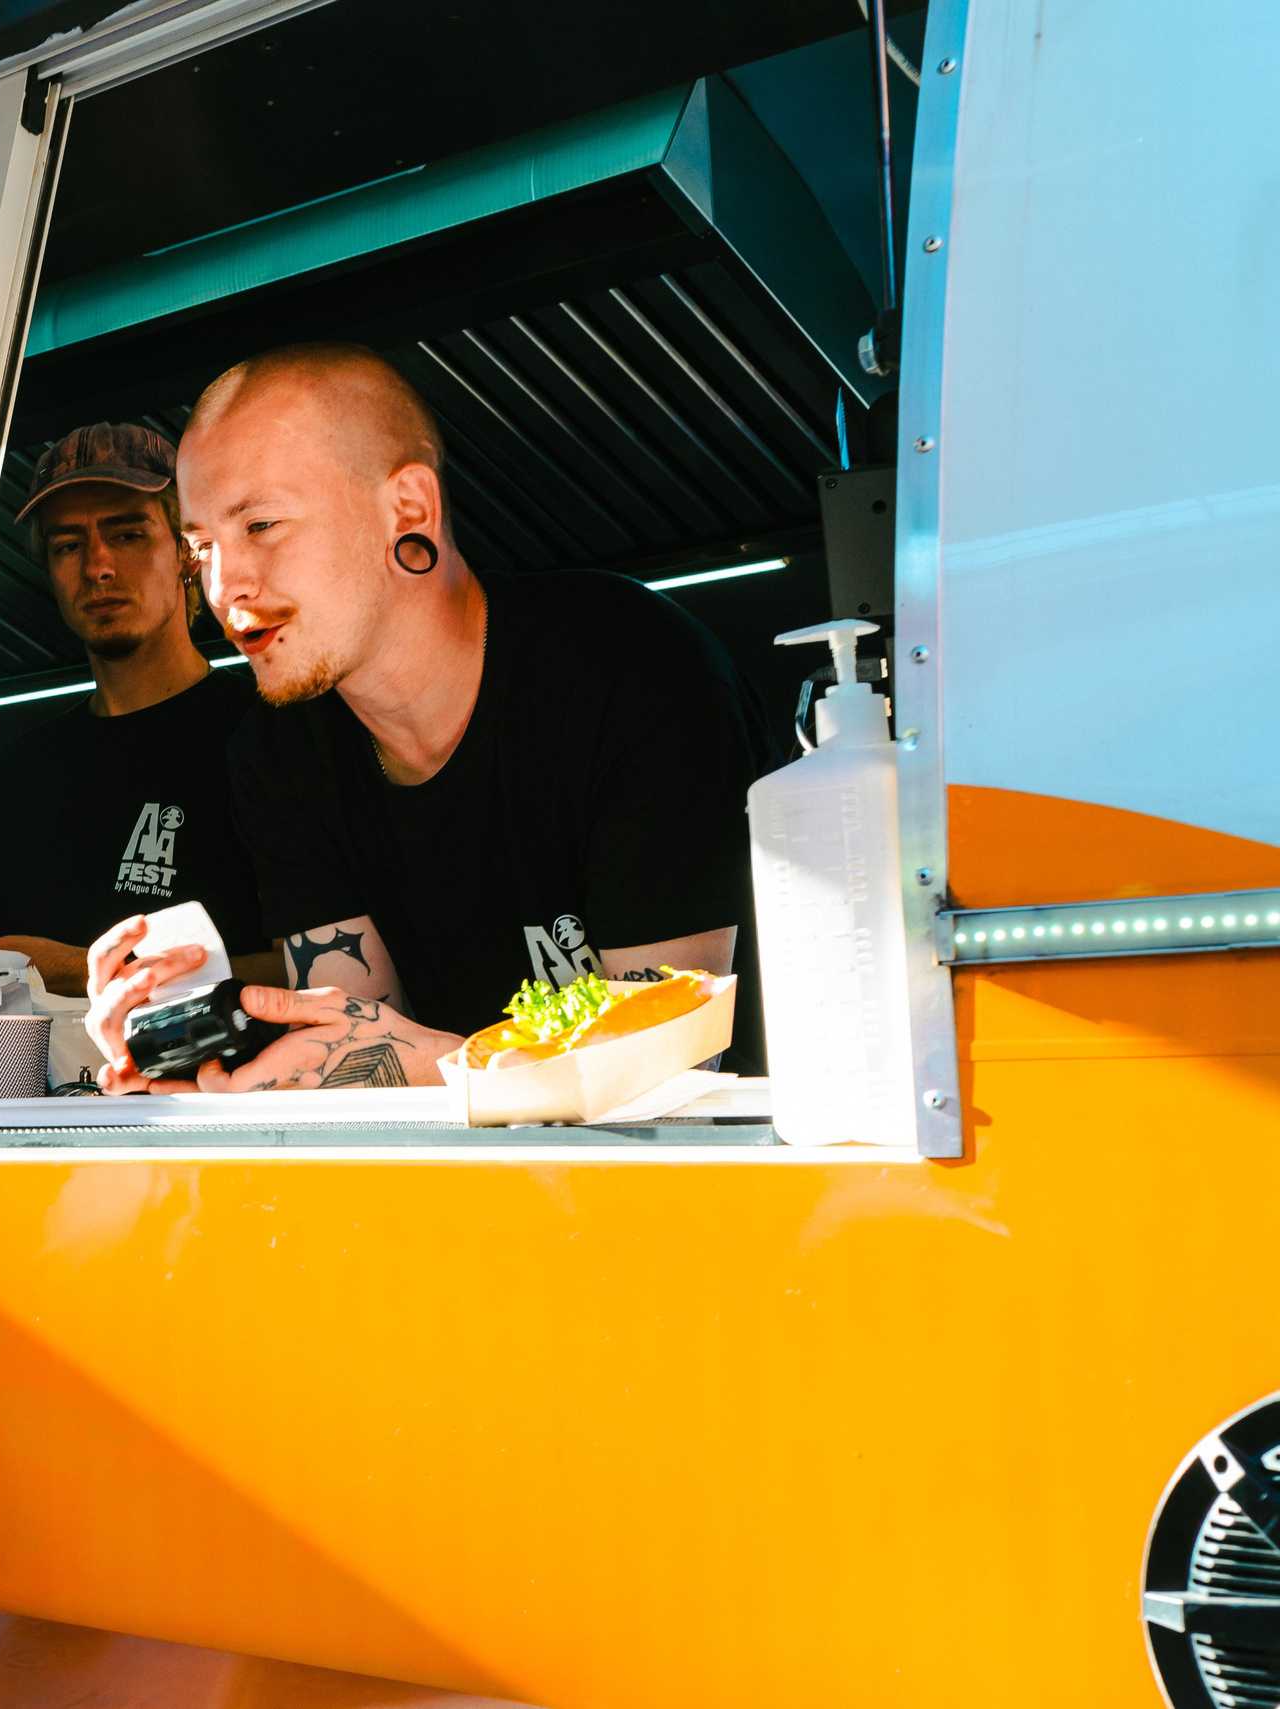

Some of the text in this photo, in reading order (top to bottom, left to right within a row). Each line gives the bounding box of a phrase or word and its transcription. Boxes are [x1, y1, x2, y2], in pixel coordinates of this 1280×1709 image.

[118, 862, 177, 887] FEST
[114, 881, 173, 898] by Plague Brew
